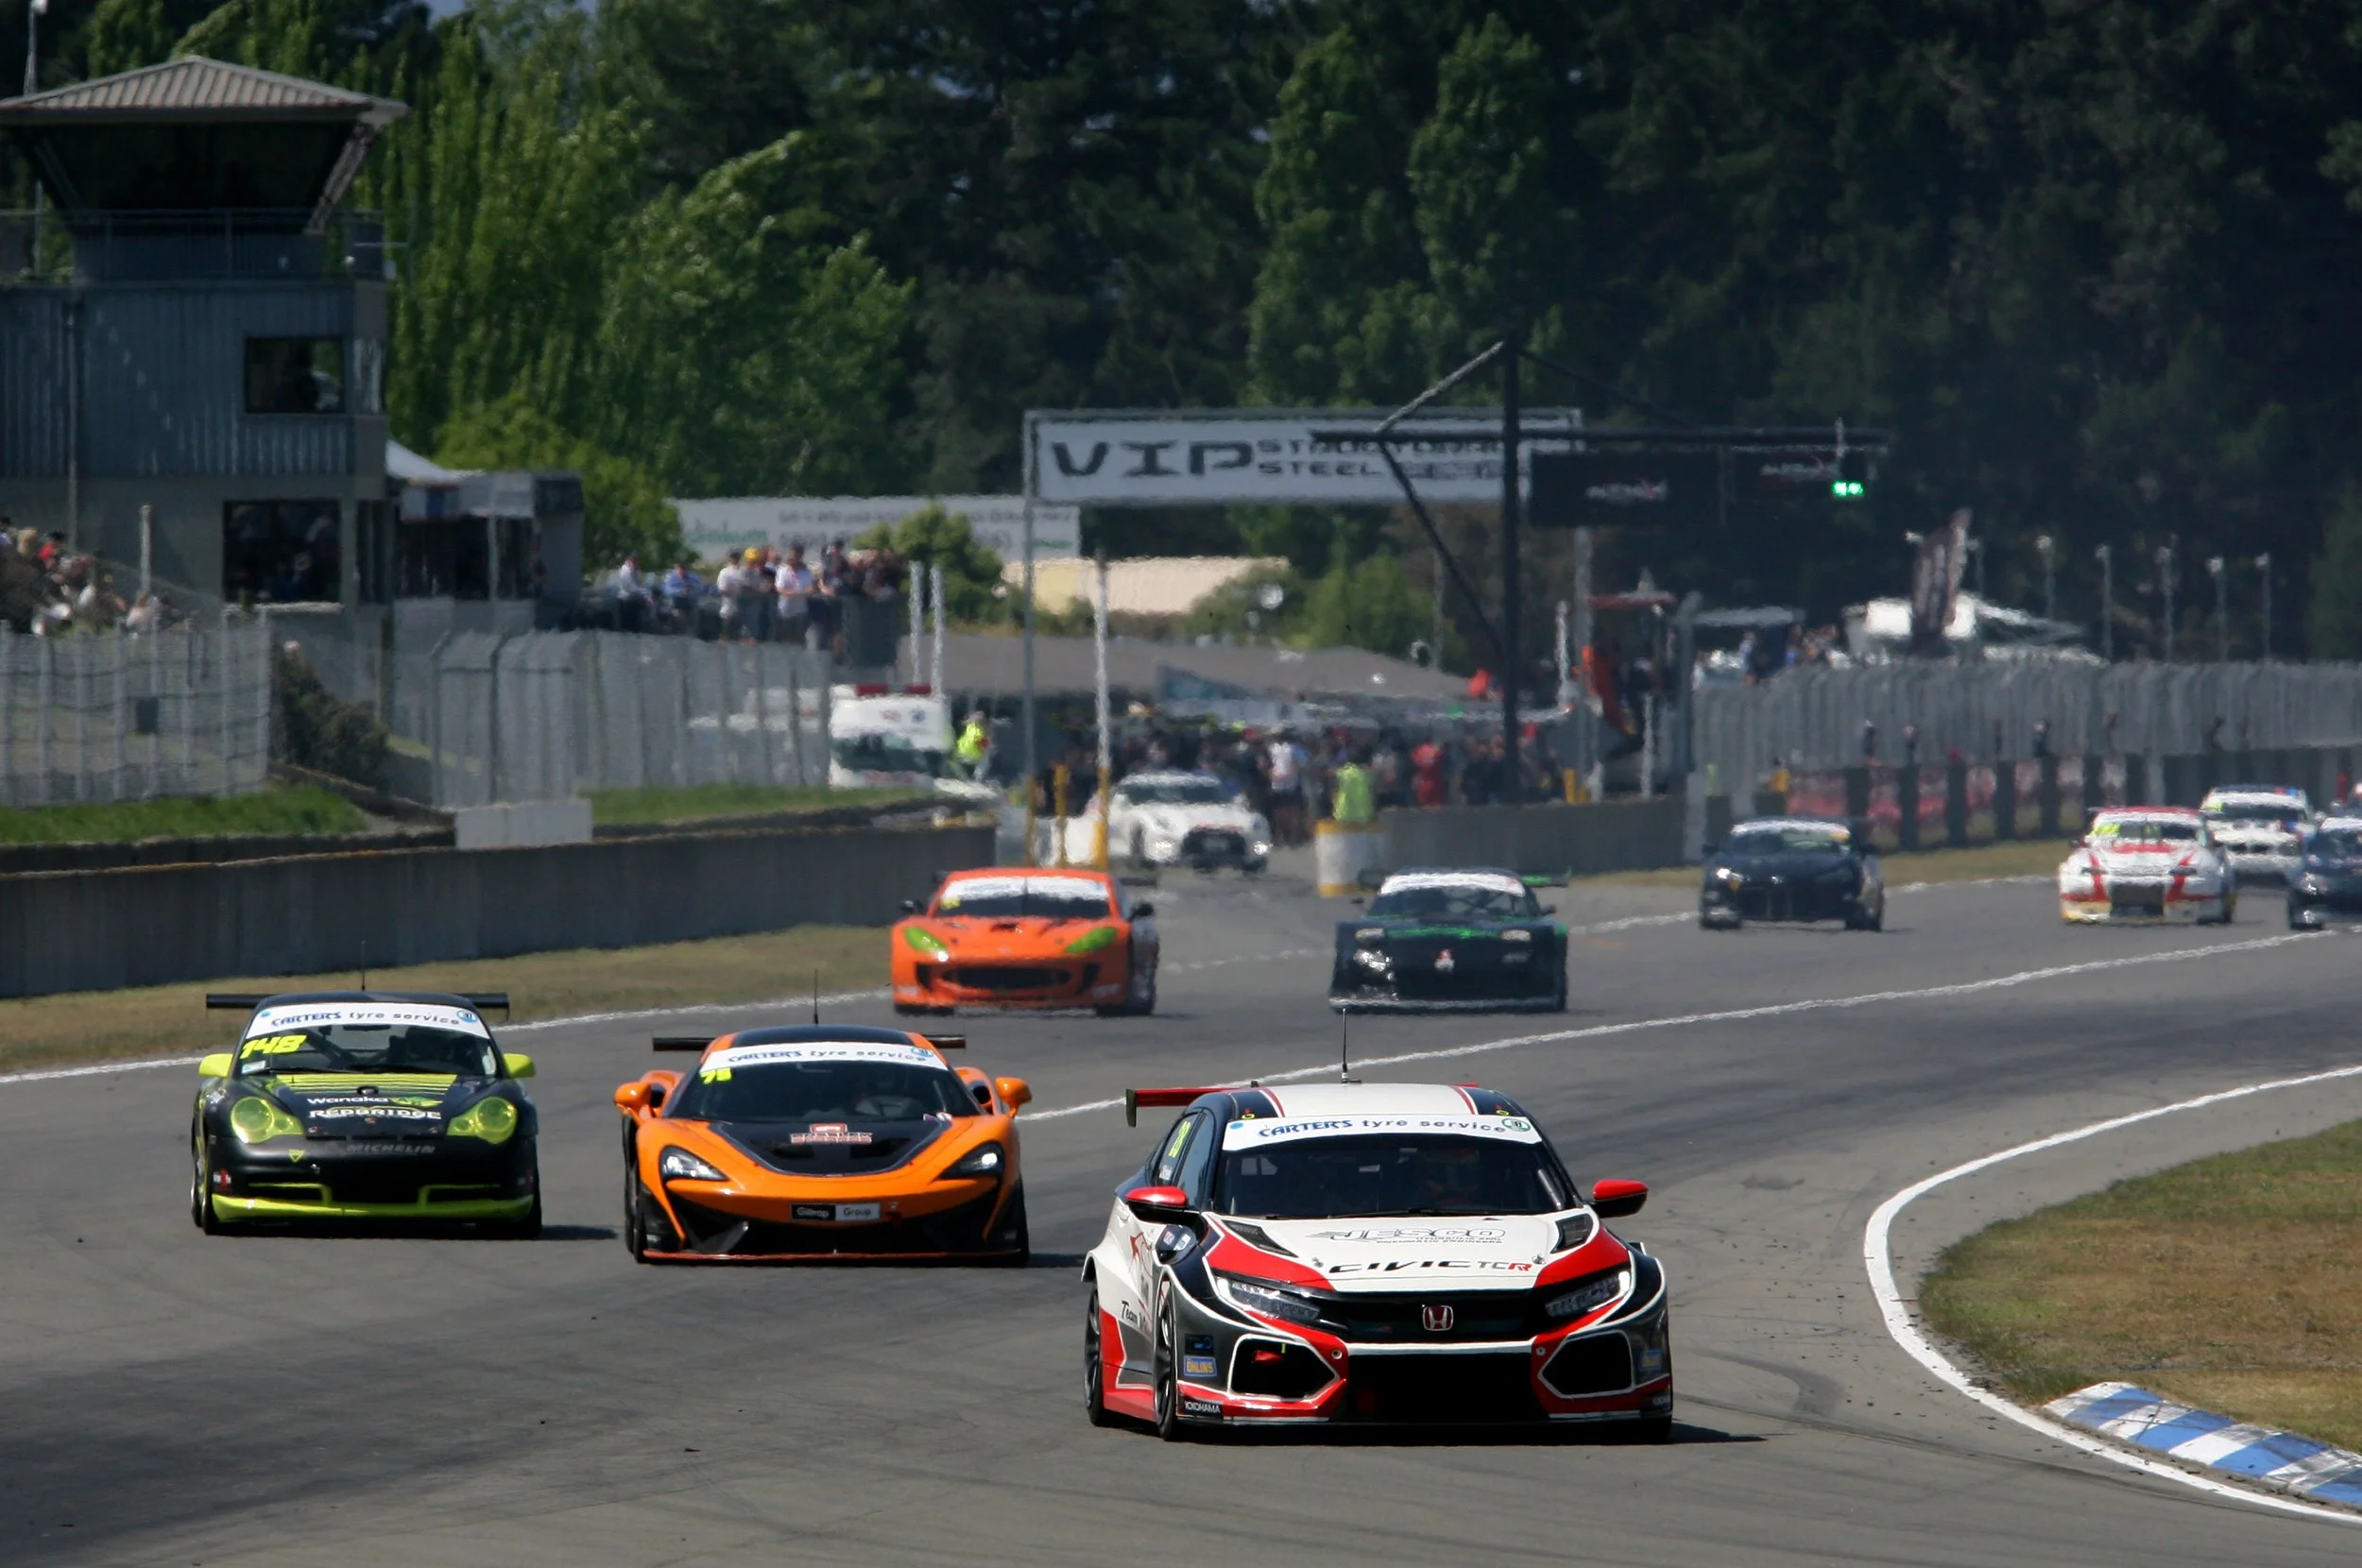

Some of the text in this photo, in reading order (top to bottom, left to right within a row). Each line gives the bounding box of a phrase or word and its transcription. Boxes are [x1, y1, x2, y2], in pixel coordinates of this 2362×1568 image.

[1051, 440, 1255, 477] VIP
[1258, 460, 1382, 477] STEEL
[349, 1012, 385, 1022] tyre
[393, 1013, 460, 1026] service
[240, 1035, 308, 1059] 148
[810, 1050, 847, 1059] tyre
[309, 1109, 442, 1119] REDBRIDGE
[1361, 1118, 1409, 1131] tyre
[1419, 1121, 1506, 1133] service
[348, 1144, 436, 1153] MICHELIN
[843, 1207, 872, 1218] Group
[1330, 1227, 1507, 1241] JESCO
[1328, 1260, 1532, 1273] CIVIC TCR
[1121, 1300, 1138, 1323] Team
[1185, 1400, 1221, 1414] YOKOHAMA
